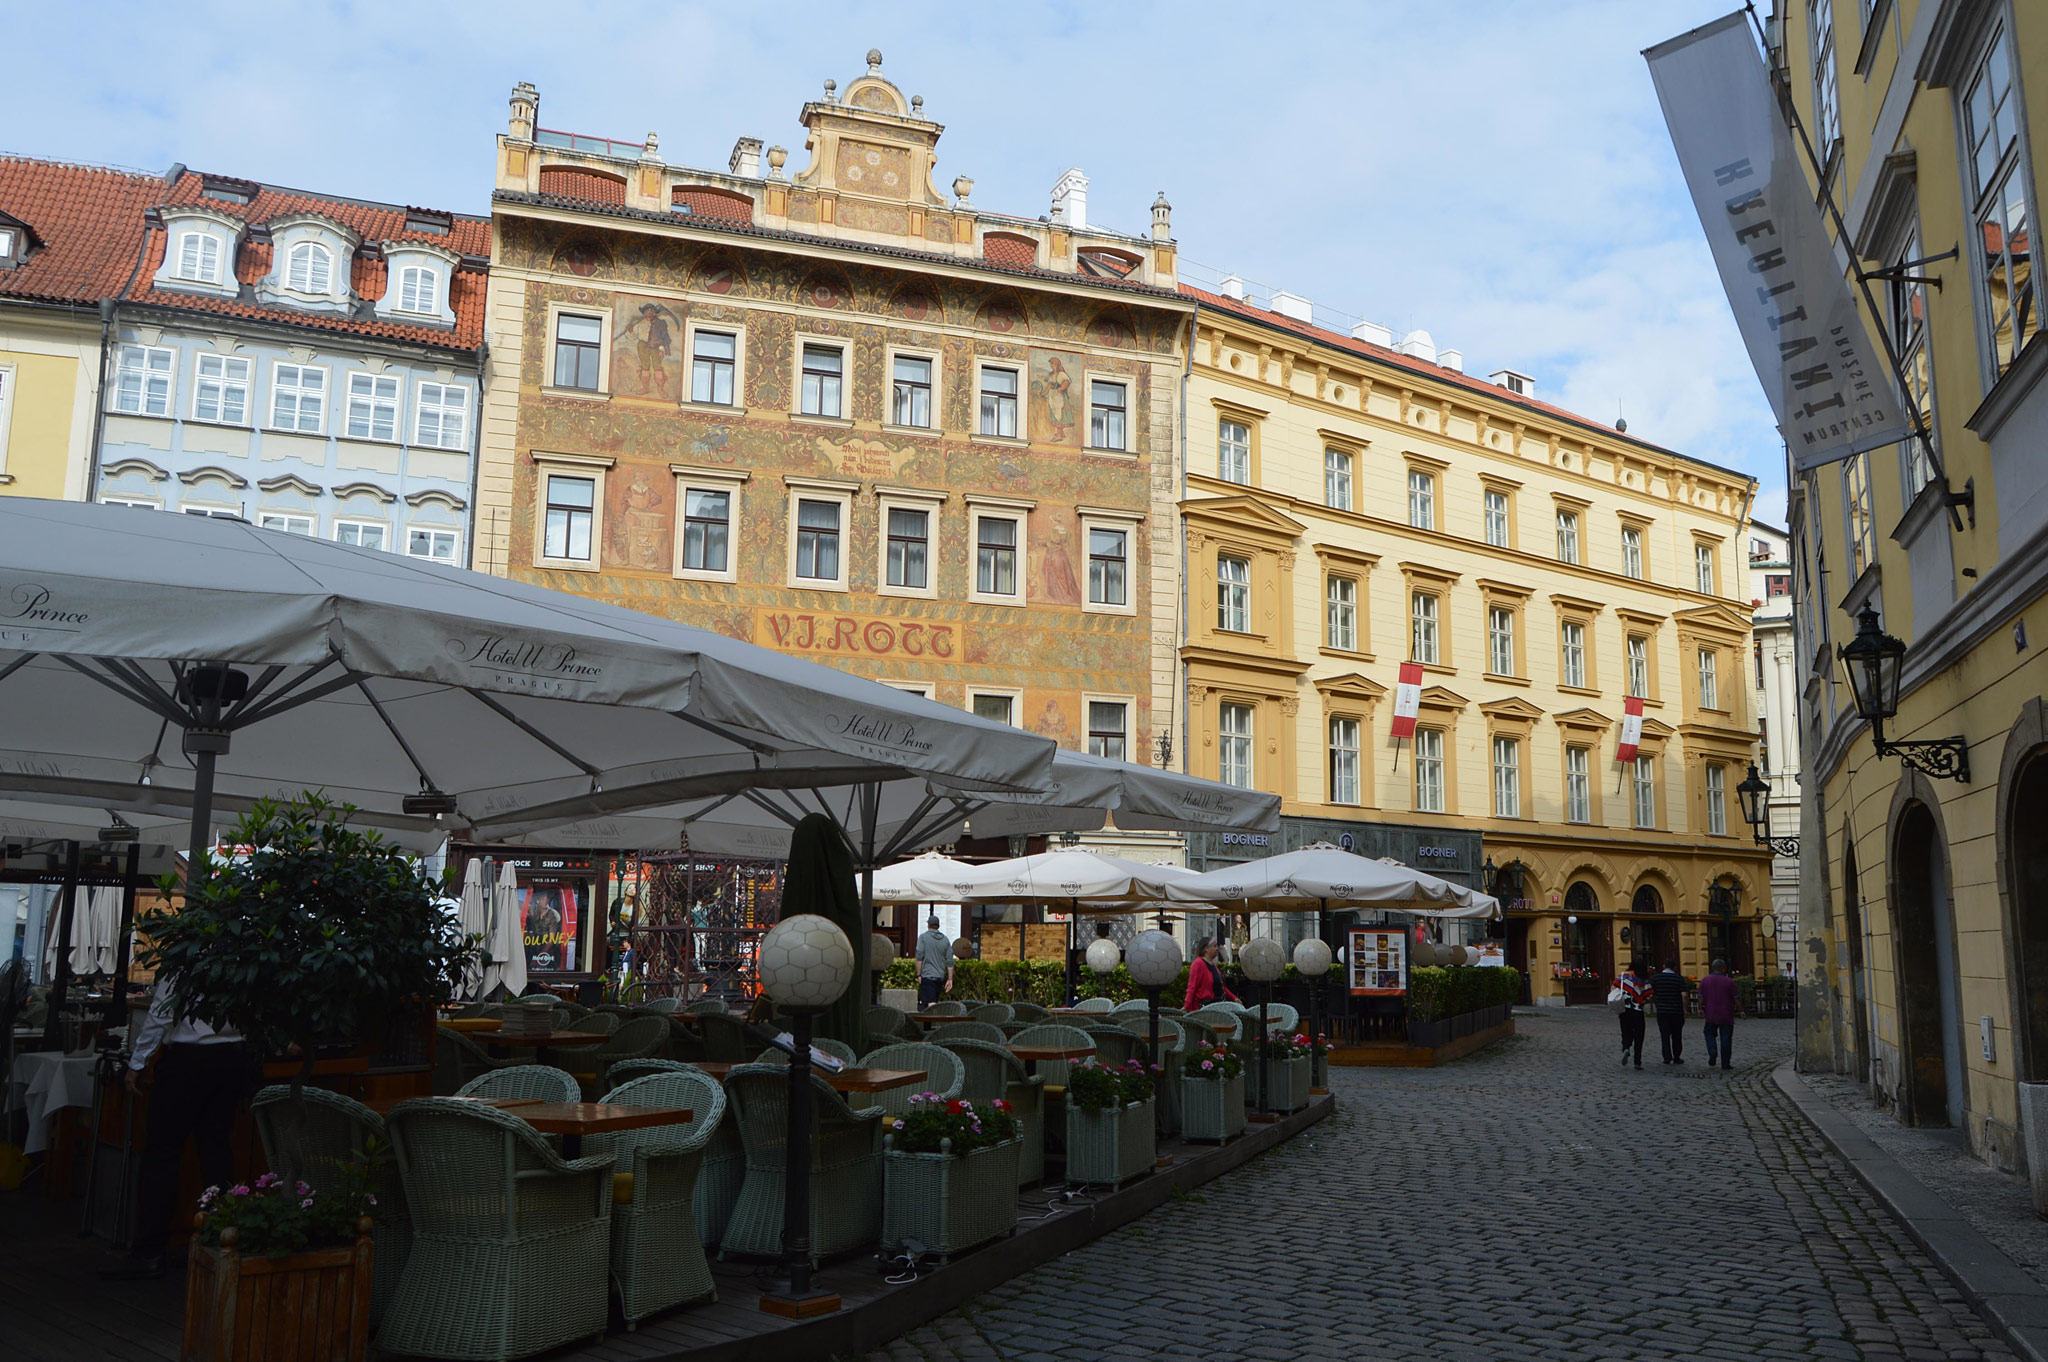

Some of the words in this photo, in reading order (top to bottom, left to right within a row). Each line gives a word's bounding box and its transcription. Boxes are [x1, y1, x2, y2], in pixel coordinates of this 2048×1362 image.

[445, 636, 526, 665] Hotel
[521, 643, 545, 668] U
[541, 643, 603, 676] Prince
[495, 675, 564, 691] PRAGUE
[824, 713, 880, 739] Hotel
[894, 721, 933, 750] Prince
[1223, 832, 1268, 847] BOGNER
[1419, 846, 1457, 858] BOGNER
[1341, 885, 1354, 893] Rock
